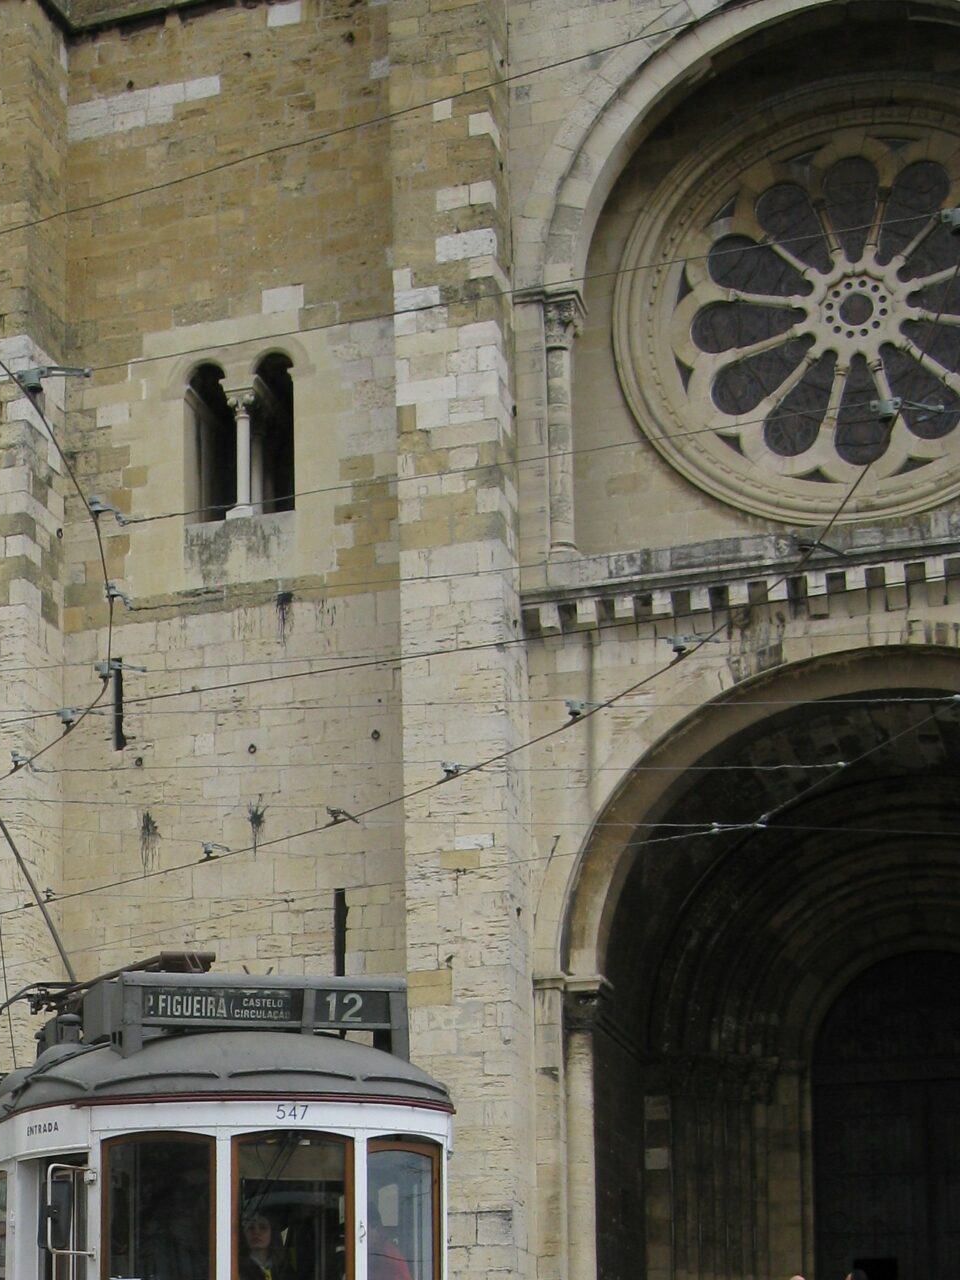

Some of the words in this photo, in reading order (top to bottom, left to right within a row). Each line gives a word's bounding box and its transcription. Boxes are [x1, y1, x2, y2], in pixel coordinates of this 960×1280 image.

[158, 994, 227, 1018] FIGUEIRA
[243, 998, 283, 1008] CASTELO
[326, 992, 362, 1022] 12
[276, 1104, 308, 1120] 547
[27, 1122, 58, 1136] ENTRADA
